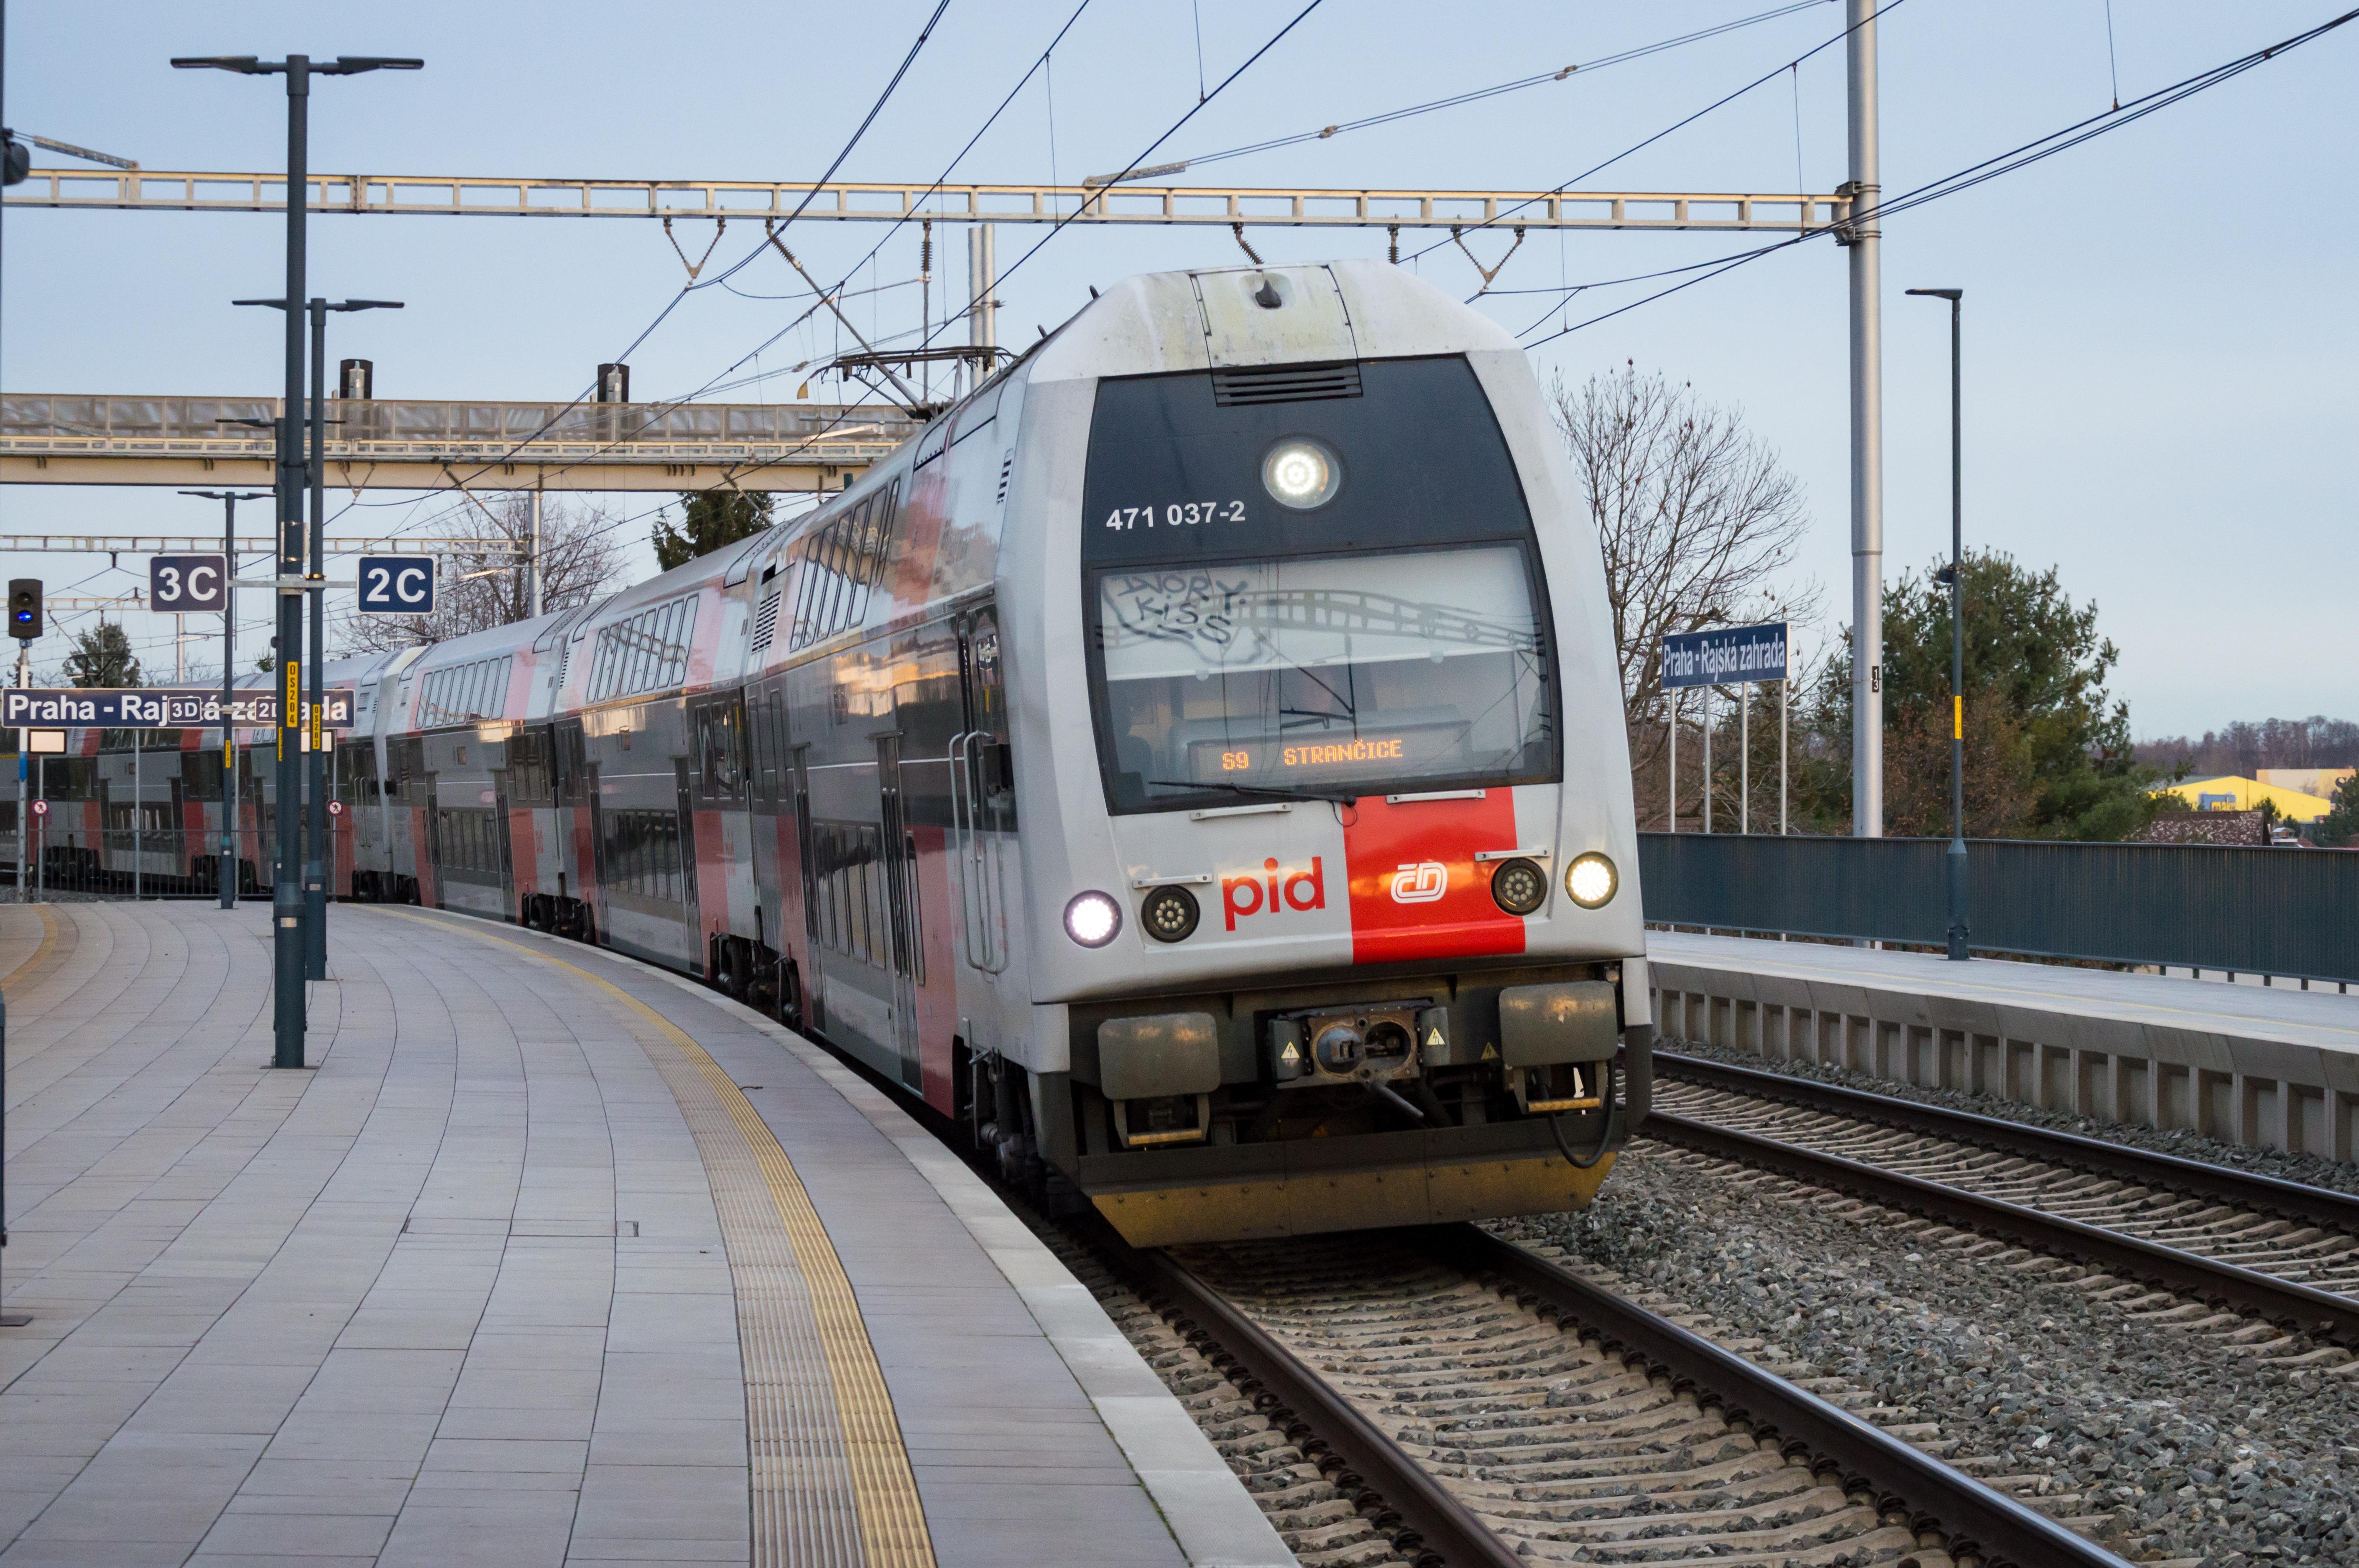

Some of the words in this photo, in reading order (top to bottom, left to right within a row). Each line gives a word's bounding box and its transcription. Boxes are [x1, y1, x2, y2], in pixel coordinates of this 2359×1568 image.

[1106, 506, 1154, 530] 471
[1167, 501, 1246, 525] 037-2
[158, 566, 217, 602] 3C
[366, 568, 426, 603] 2C
[1664, 642, 1693, 677] Praha
[1701, 636, 1737, 683] Rajská
[1739, 632, 1785, 671] zahrada
[9, 695, 95, 720] Praha
[121, 695, 220, 727] Rajá
[172, 702, 198, 717] 3D
[258, 702, 276, 717] 2
[1222, 751, 1249, 770] S9
[1284, 739, 1403, 766] STRANČICE
[1222, 856, 1325, 932] pid
